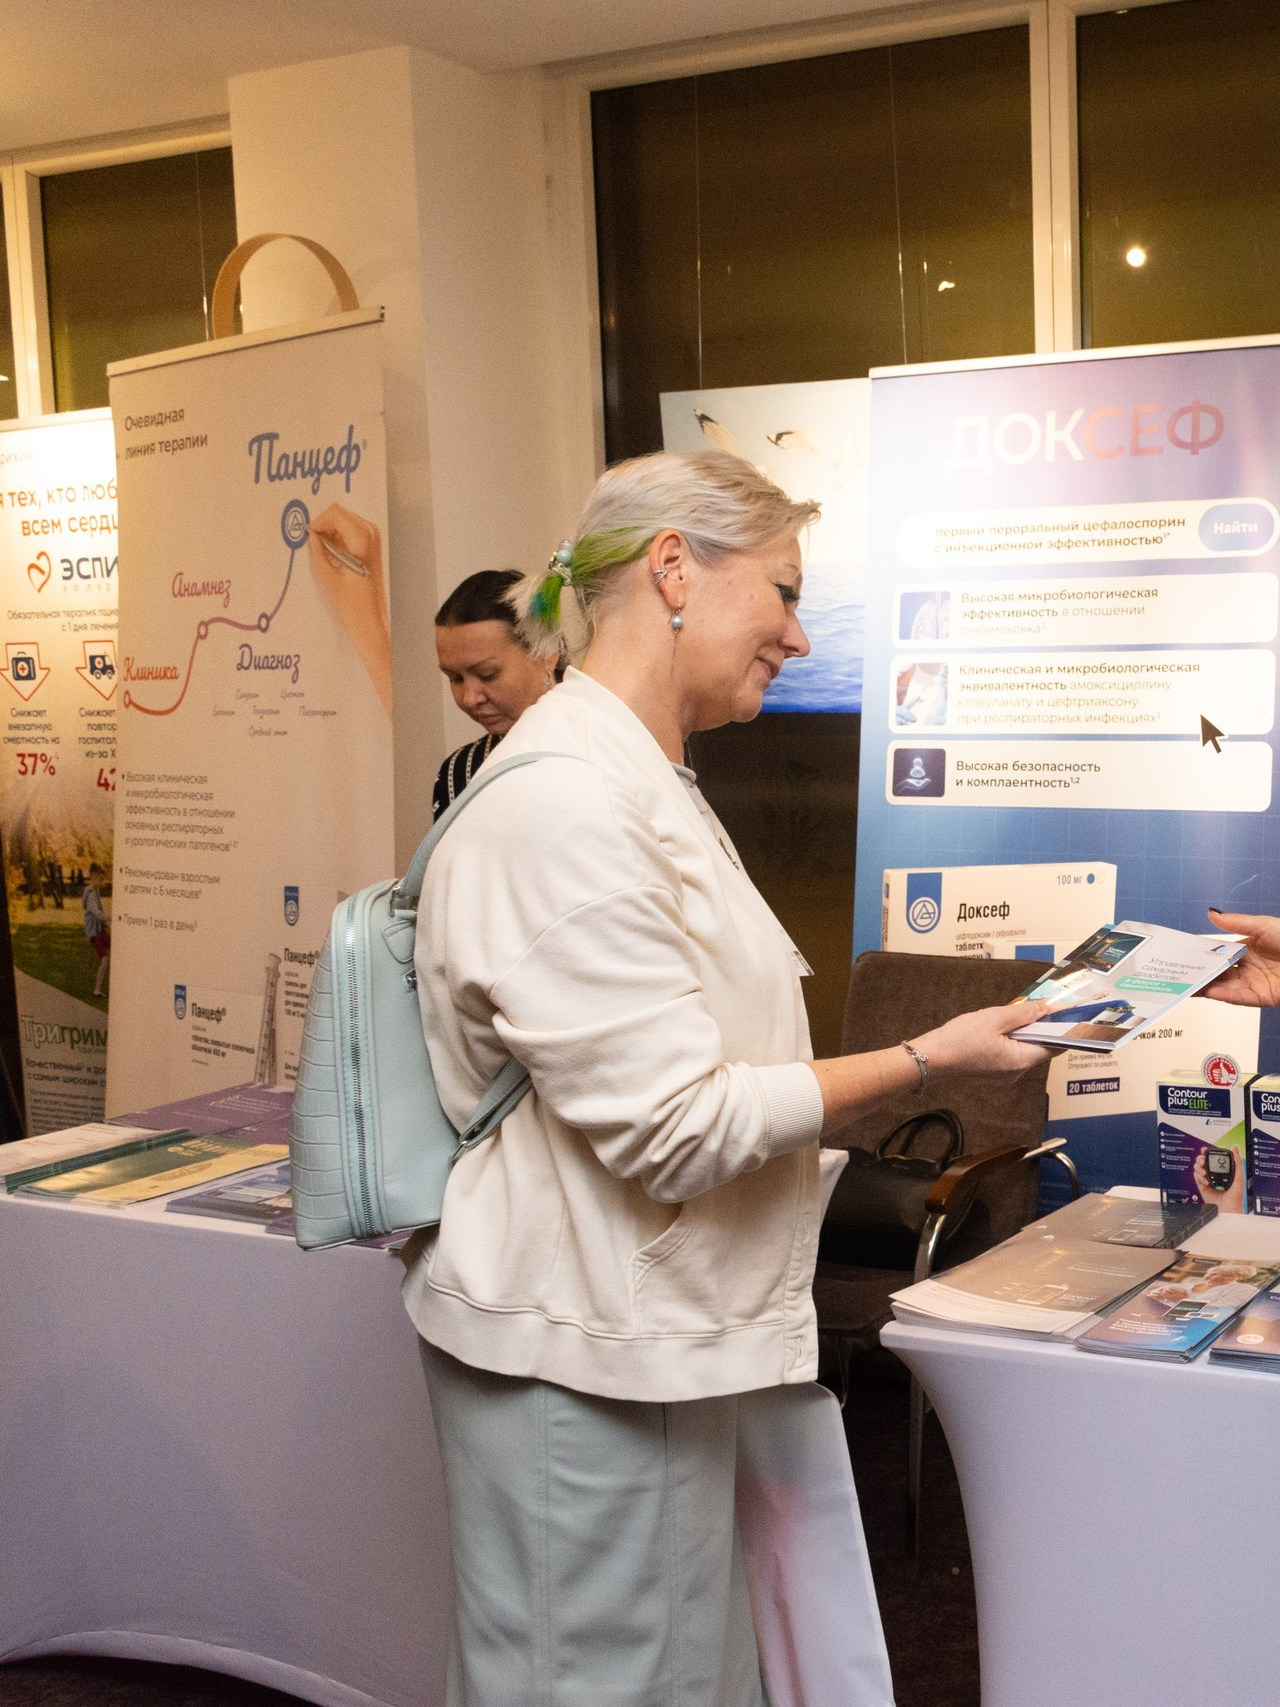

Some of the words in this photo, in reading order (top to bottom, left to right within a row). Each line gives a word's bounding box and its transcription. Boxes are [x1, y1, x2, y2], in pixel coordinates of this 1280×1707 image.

[124, 408, 185, 432] Очевидная
[124, 445, 156, 461] линия
[157, 433, 208, 457] терапии
[943, 399, 1225, 479] ДОКСЕФ
[47, 486, 77, 505] кто
[22, 518, 62, 536] всем
[934, 524, 986, 540] первый
[988, 520, 1080, 539] пероральный
[1082, 515, 1187, 533] цефалоспорин
[1213, 520, 1259, 536] Найти
[934, 545, 942, 554] с
[944, 538, 1043, 554] инъекционной
[172, 571, 232, 609] Анамнез
[960, 592, 1015, 604] Высокая
[1018, 588, 1158, 605] микробиологическая
[960, 606, 1059, 621] эффективность
[1062, 608, 1069, 617] в
[1071, 605, 1146, 617] отношении
[123, 656, 180, 683] Клиника
[236, 643, 302, 684] Диагноз
[959, 664, 1042, 677] Клиническая
[1046, 666, 1053, 675] и
[1057, 662, 1201, 678] микробиологическая
[958, 680, 1068, 692] эквивалентность
[1070, 679, 1173, 693] амоксициллину
[1035, 697, 1044, 707] и
[1047, 694, 1139, 710] цефтриаксону
[10, 707, 47, 718] Снижает
[957, 713, 982, 725] при
[984, 711, 1082, 726] респираторных
[8, 723, 53, 733] внезапную
[3, 736, 50, 746] смертность
[51, 737, 60, 745] на
[956, 760, 1010, 773] Высокая
[1012, 759, 1102, 773] безопасность
[955, 778, 964, 788] и
[1057, 873, 1072, 885] 100
[957, 901, 1010, 923] Доксеф
[1158, 1029, 1173, 1040] 200
[1069, 1081, 1080, 1094] 20
[1082, 1079, 1119, 1093] таблеток
[1167, 1087, 1208, 1099] Contour
[1167, 1096, 1189, 1108] plus
[1189, 1099, 1209, 1110] ELITE
